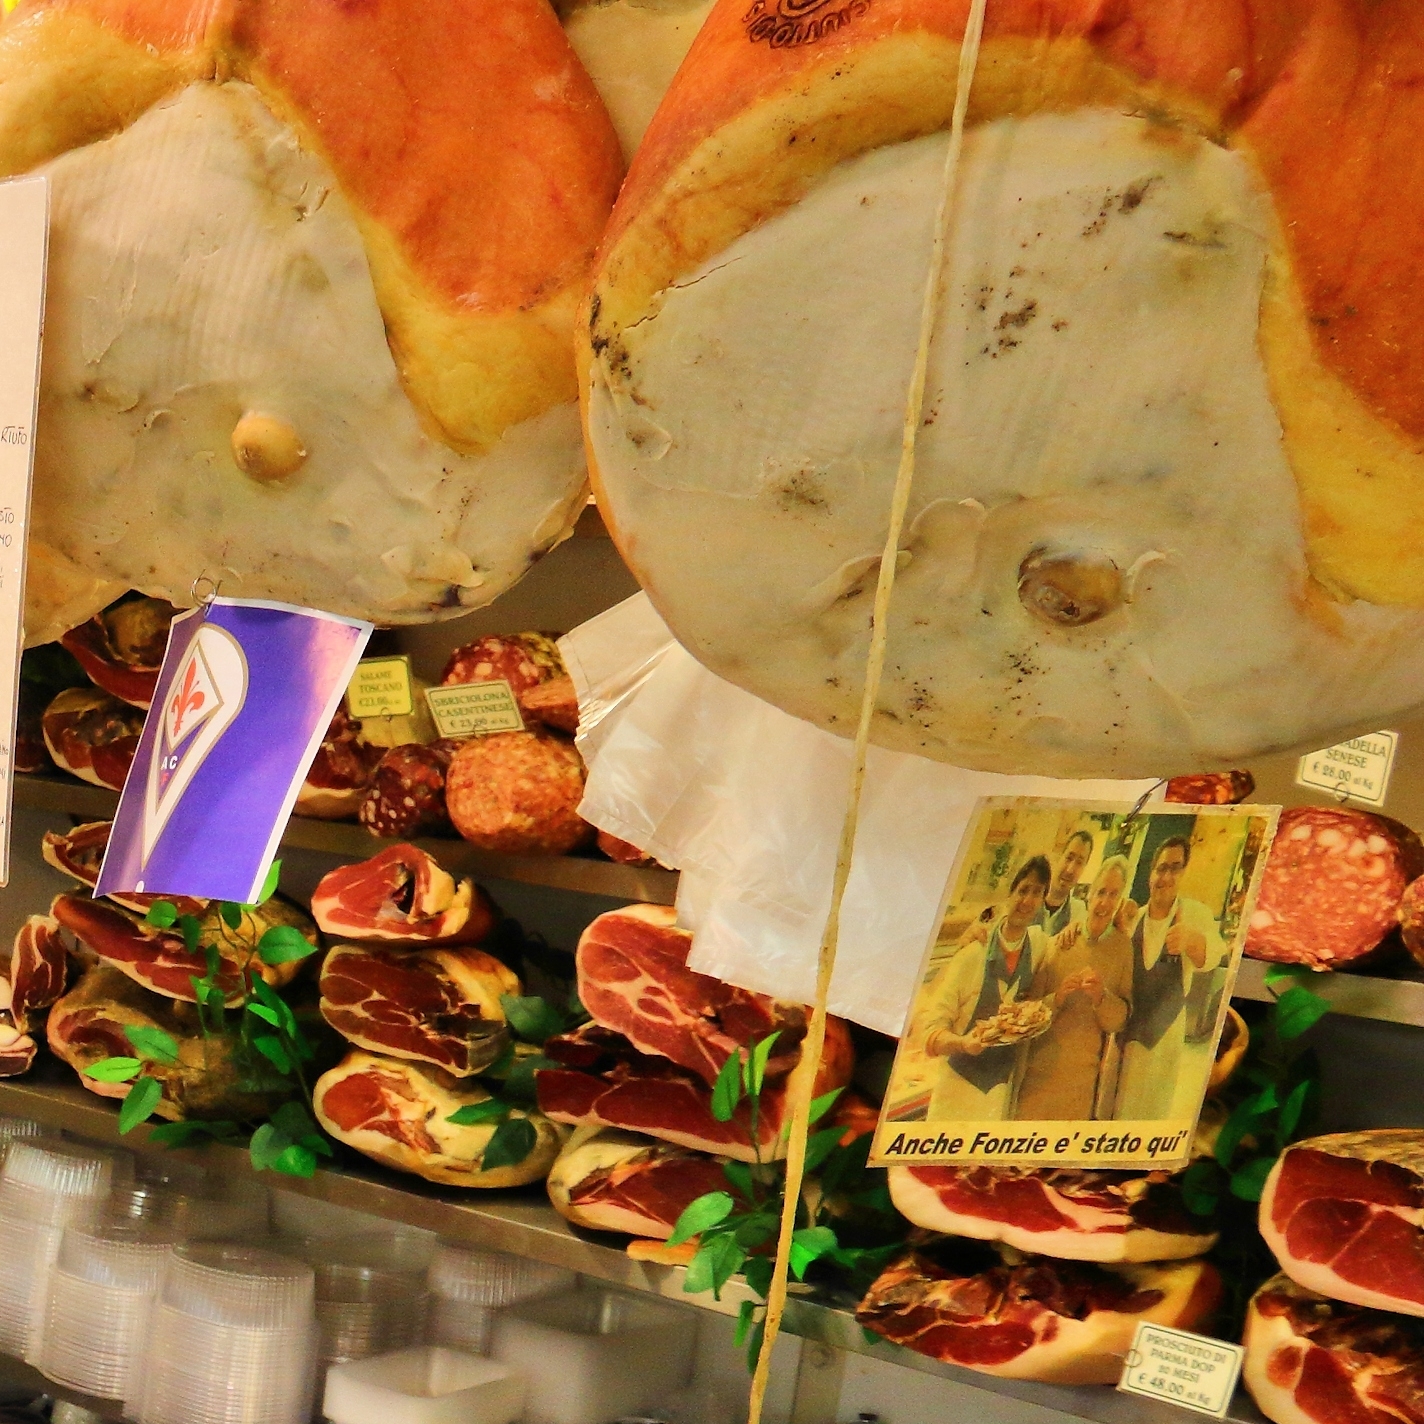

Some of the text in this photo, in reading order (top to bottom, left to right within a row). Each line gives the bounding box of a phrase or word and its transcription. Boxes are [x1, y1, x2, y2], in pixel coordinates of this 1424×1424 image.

[358, 682, 403, 694] TOSCANO
[436, 702, 514, 718] CASENTINESE
[1336, 738, 1387, 758] ADELLA
[1326, 748, 1369, 770] SENESE
[884, 1132, 965, 1156] Anche
[968, 1131, 1049, 1155] Fonzie
[1081, 1131, 1142, 1154] stato
[1191, 1359, 1217, 1373] DOP
[1172, 1367, 1201, 1384] MESI
